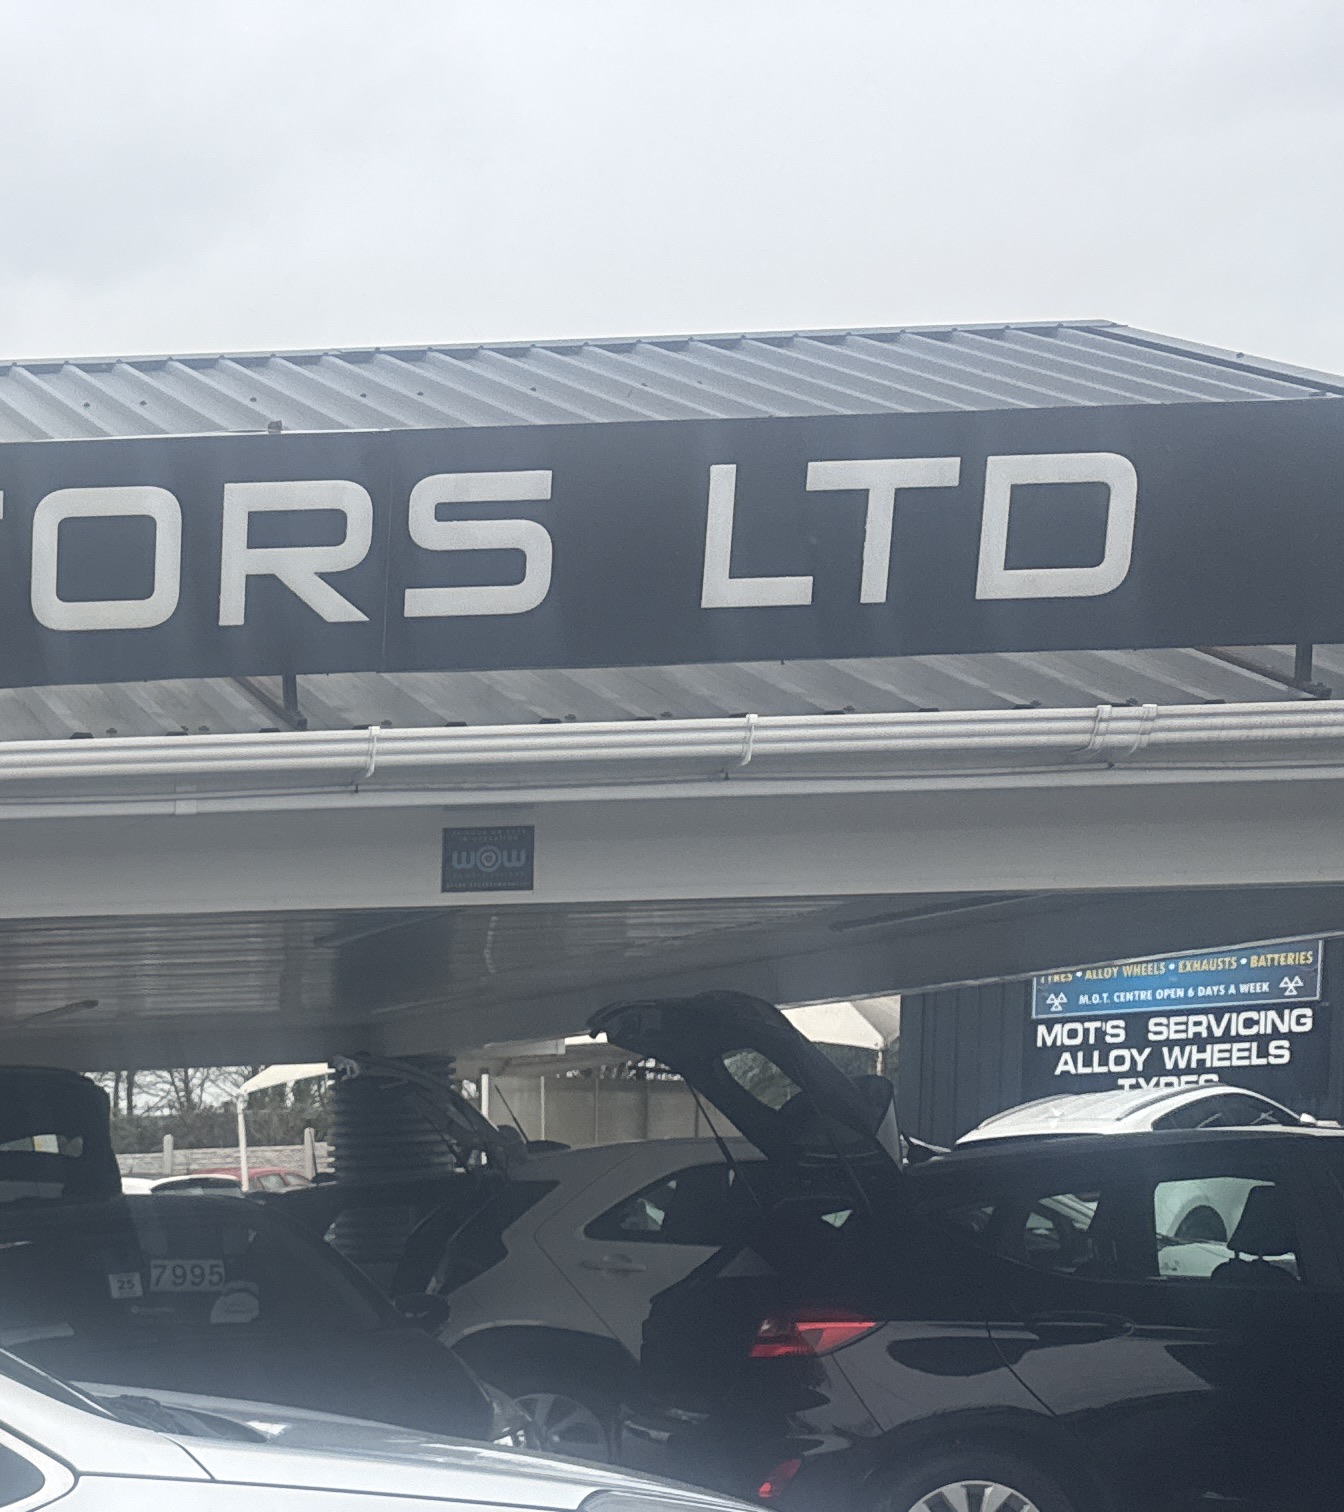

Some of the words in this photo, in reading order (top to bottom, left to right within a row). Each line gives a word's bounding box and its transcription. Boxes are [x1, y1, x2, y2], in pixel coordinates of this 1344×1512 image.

[700, 452, 1138, 608] LTD
[1084, 966, 1120, 981] ALLOY
[1122, 962, 1166, 979] WHEELS
[1178, 956, 1238, 974] EXHAUSTS
[1249, 951, 1314, 969] BATTERIES
[1114, 989, 1153, 1003] CENTRE
[1155, 987, 1185, 1000] OPEN
[1187, 987, 1195, 998] 6
[1197, 984, 1226, 997] DAYS
[1228, 983, 1237, 995] A
[1239, 981, 1270, 993] WEEK
[1036, 1019, 1126, 1048] MOT'S
[1148, 1007, 1314, 1042] SERVICING
[1054, 1047, 1152, 1075] ALLOY
[1162, 1040, 1291, 1070] WHEELS
[152, 1263, 225, 1287] 7995
